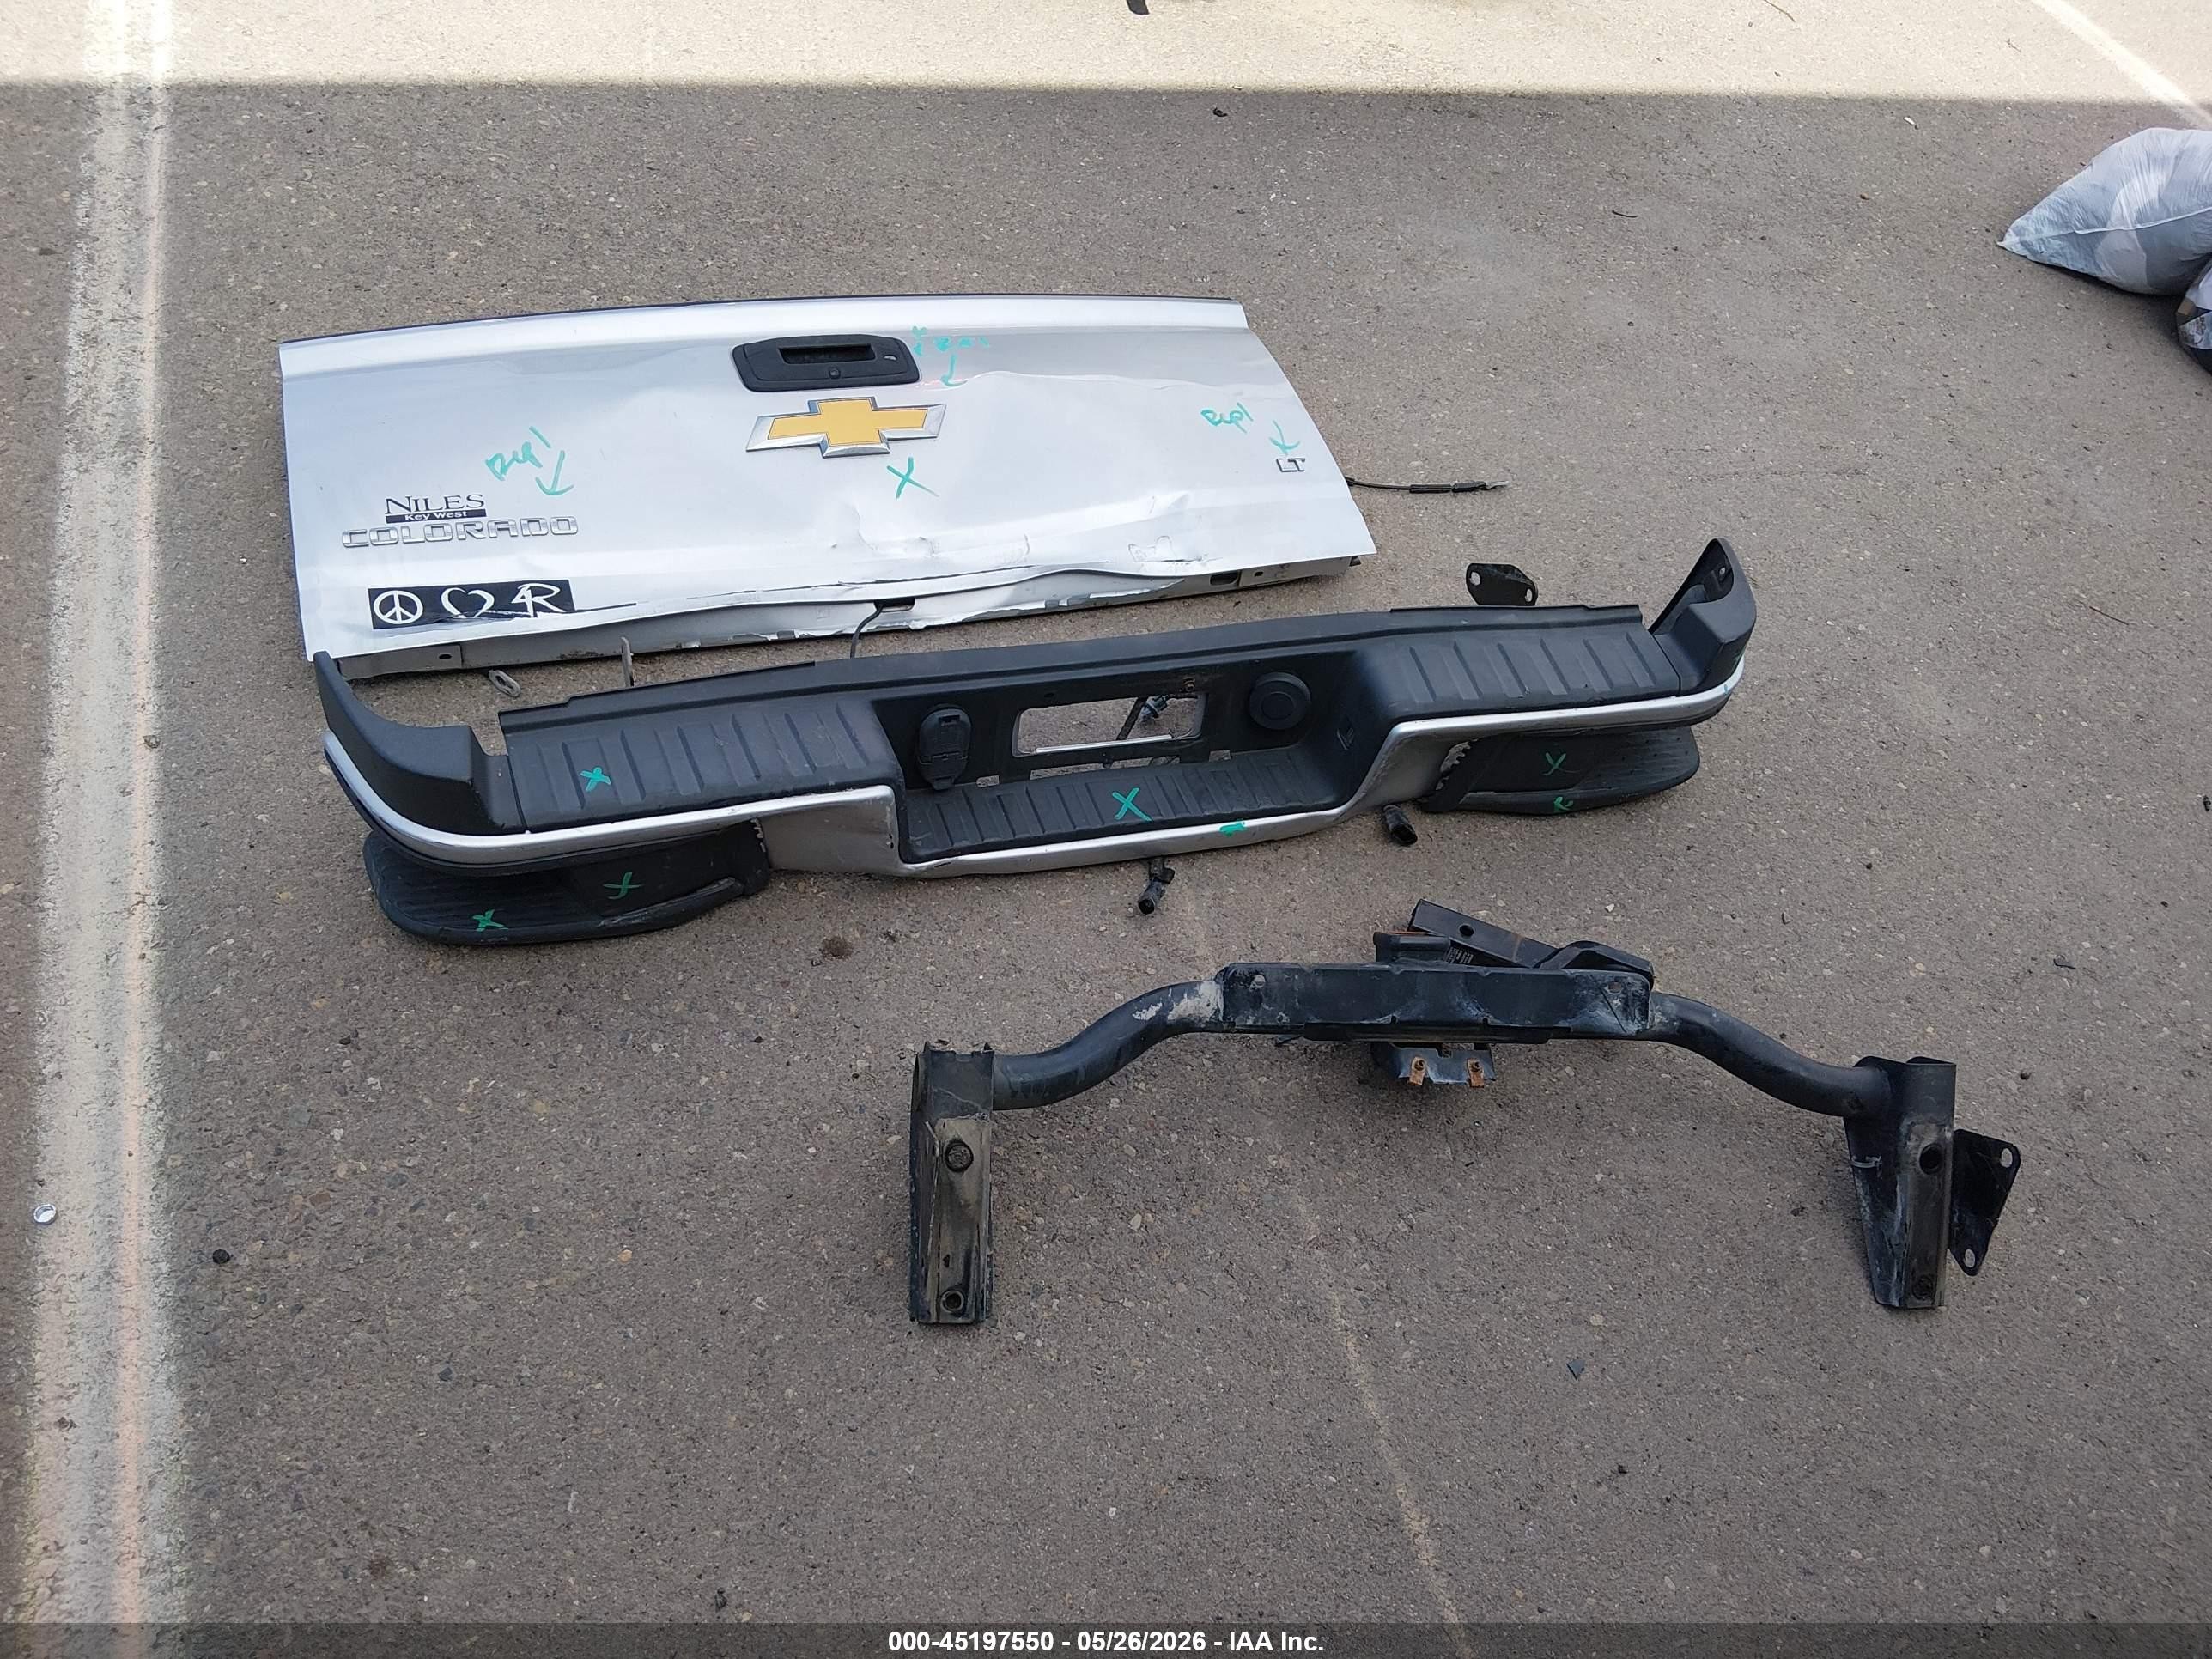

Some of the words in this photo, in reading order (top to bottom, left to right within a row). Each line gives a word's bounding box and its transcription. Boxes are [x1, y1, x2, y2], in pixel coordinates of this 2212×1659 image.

[1276, 457, 1306, 473] LT
[385, 494, 485, 514] NILES
[433, 510, 468, 519] West
[342, 515, 578, 548] COLORADO
